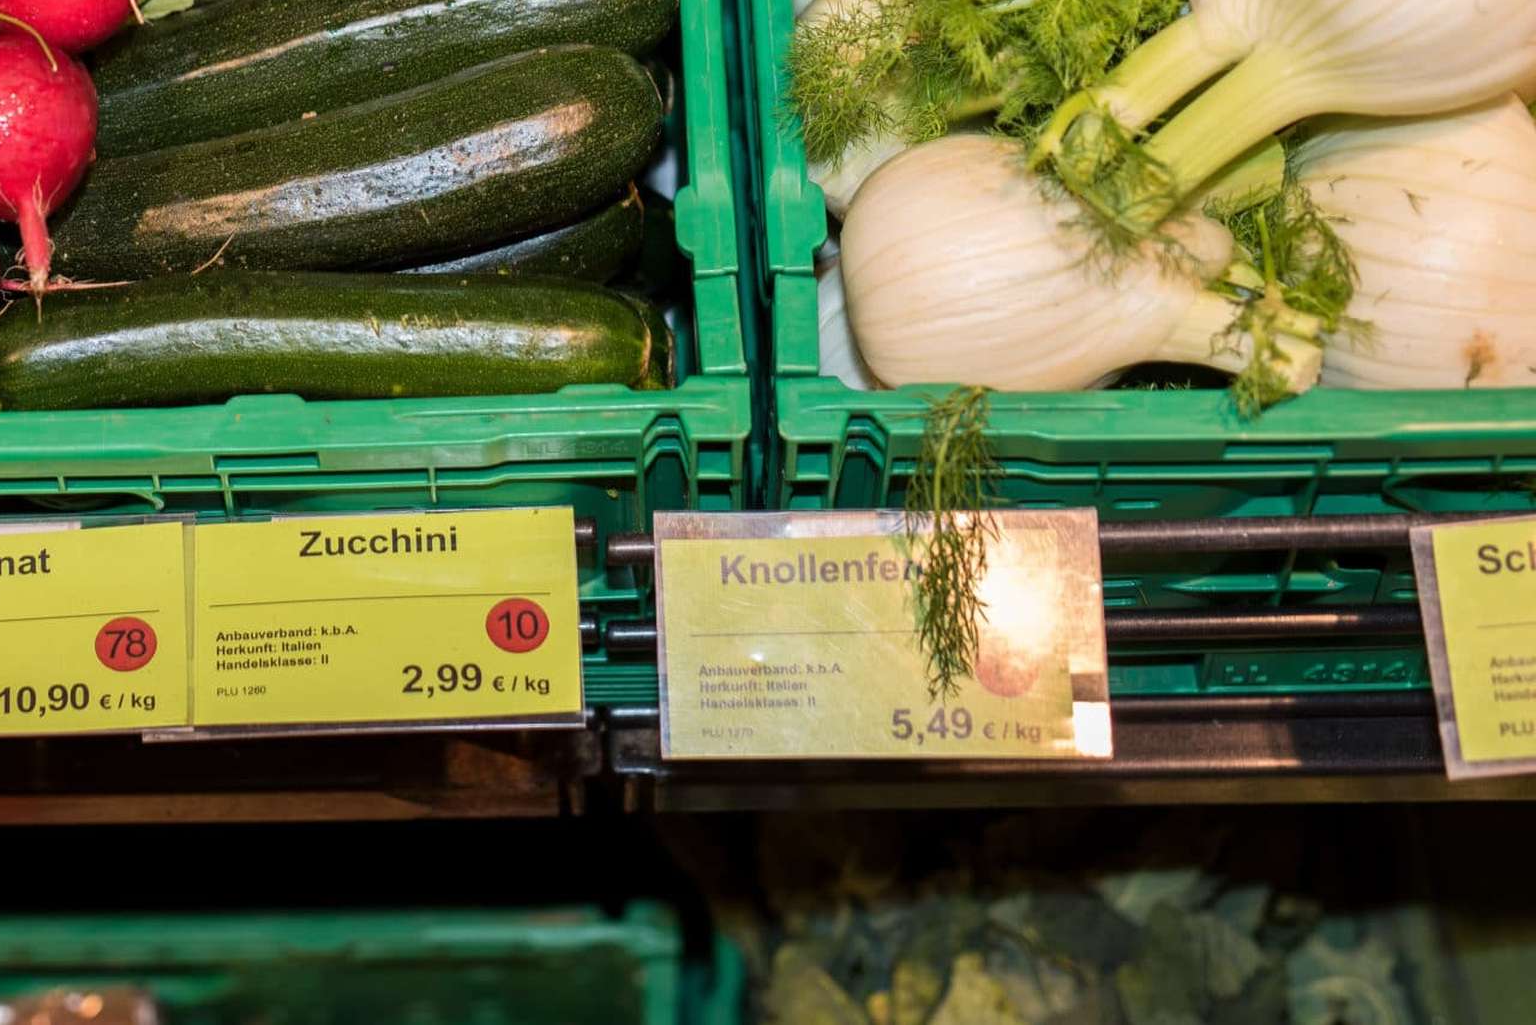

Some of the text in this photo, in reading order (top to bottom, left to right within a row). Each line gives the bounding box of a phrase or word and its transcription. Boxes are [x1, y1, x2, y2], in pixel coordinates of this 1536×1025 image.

[299, 526, 458, 557] Zucchini
[720, 552, 924, 585] Knollenfen
[216, 626, 358, 642] Anbauverband: k.b.A.
[497, 610, 539, 641] 10
[105, 628, 147, 659] 78
[216, 641, 322, 656] Herkunft: Italien
[216, 655, 329, 671] Handelsklasse: II
[216, 687, 238, 697] PLU
[402, 663, 482, 698] 2,99
[891, 707, 973, 745] 5,49
[1500, 721, 1534, 736] PLU
